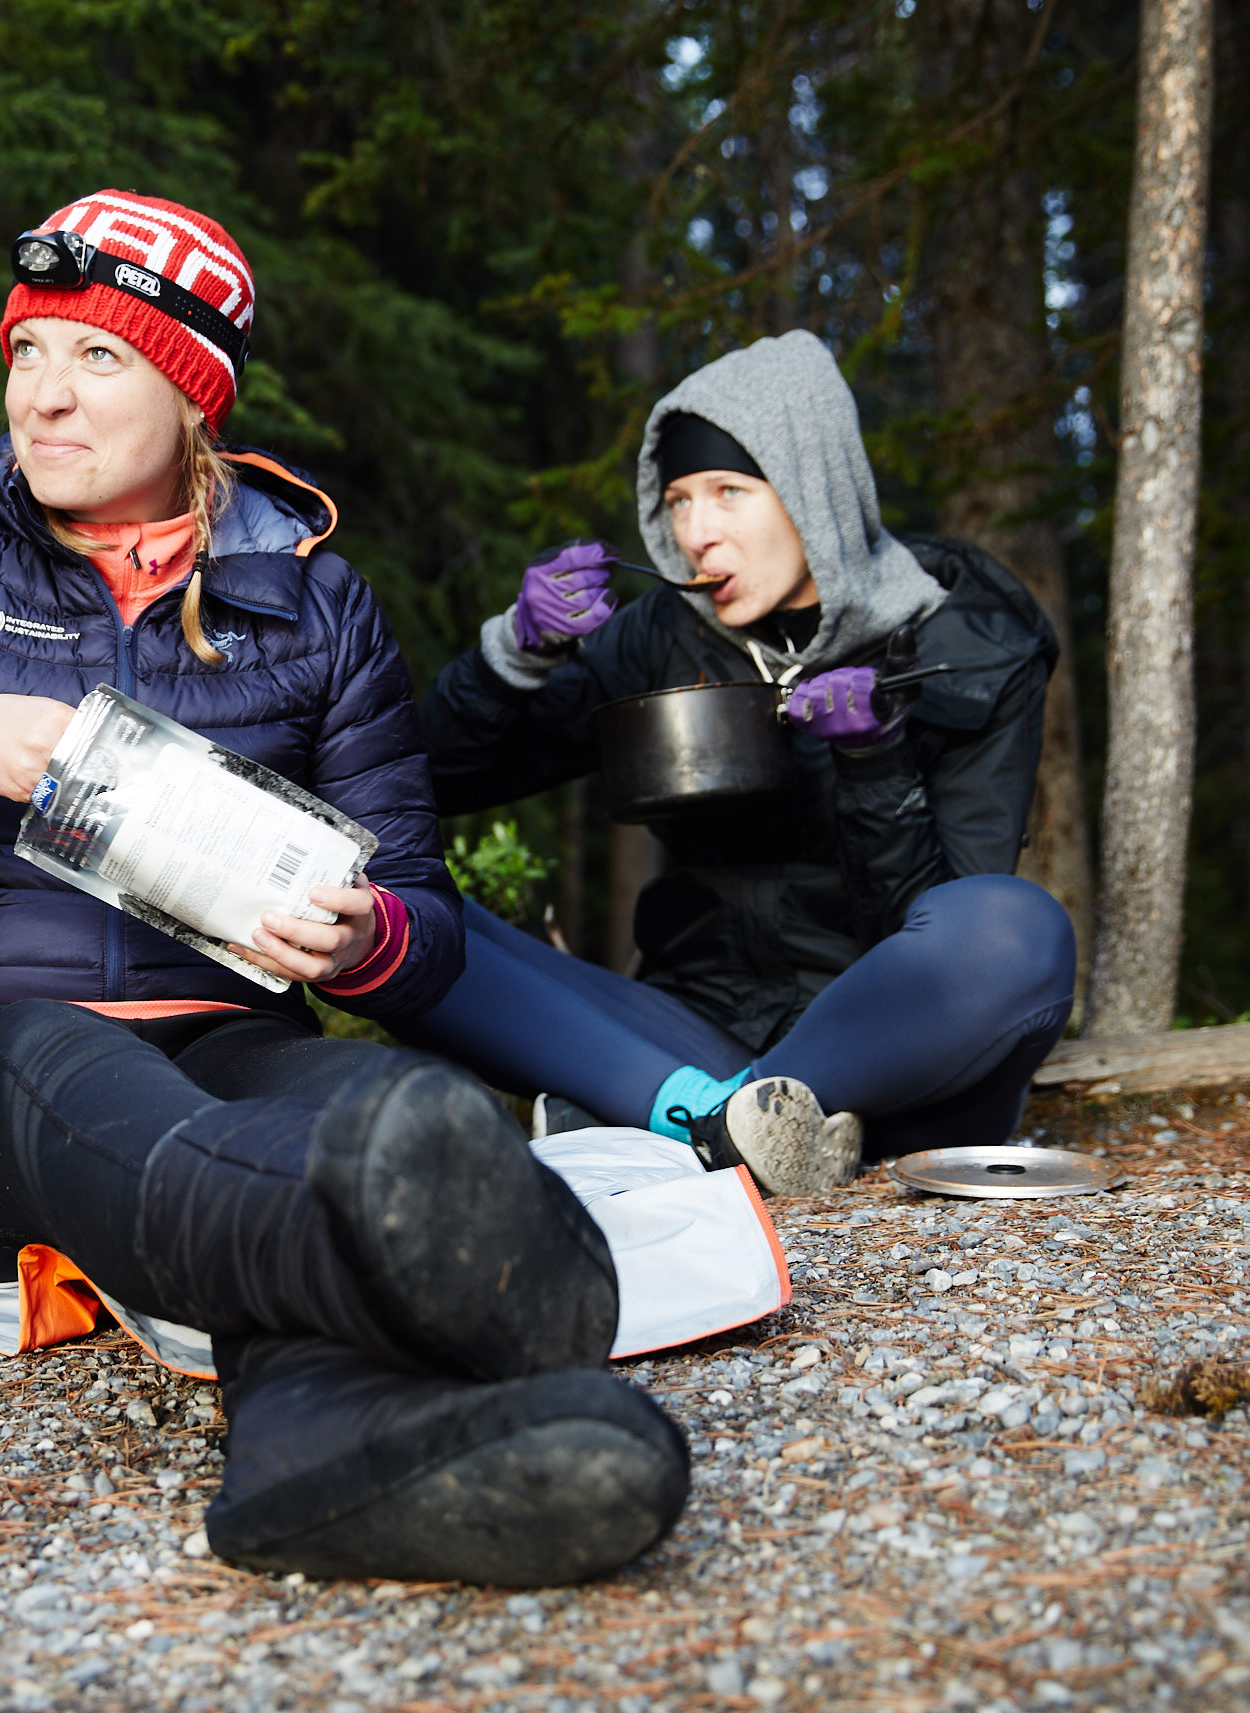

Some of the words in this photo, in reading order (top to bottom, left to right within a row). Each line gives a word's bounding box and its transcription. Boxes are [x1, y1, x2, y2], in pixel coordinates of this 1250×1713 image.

[116, 265, 160, 296] PETZL
[4, 624, 81, 640] SUSTAINABILITY
[6, 616, 65, 633] INTEGRATED
